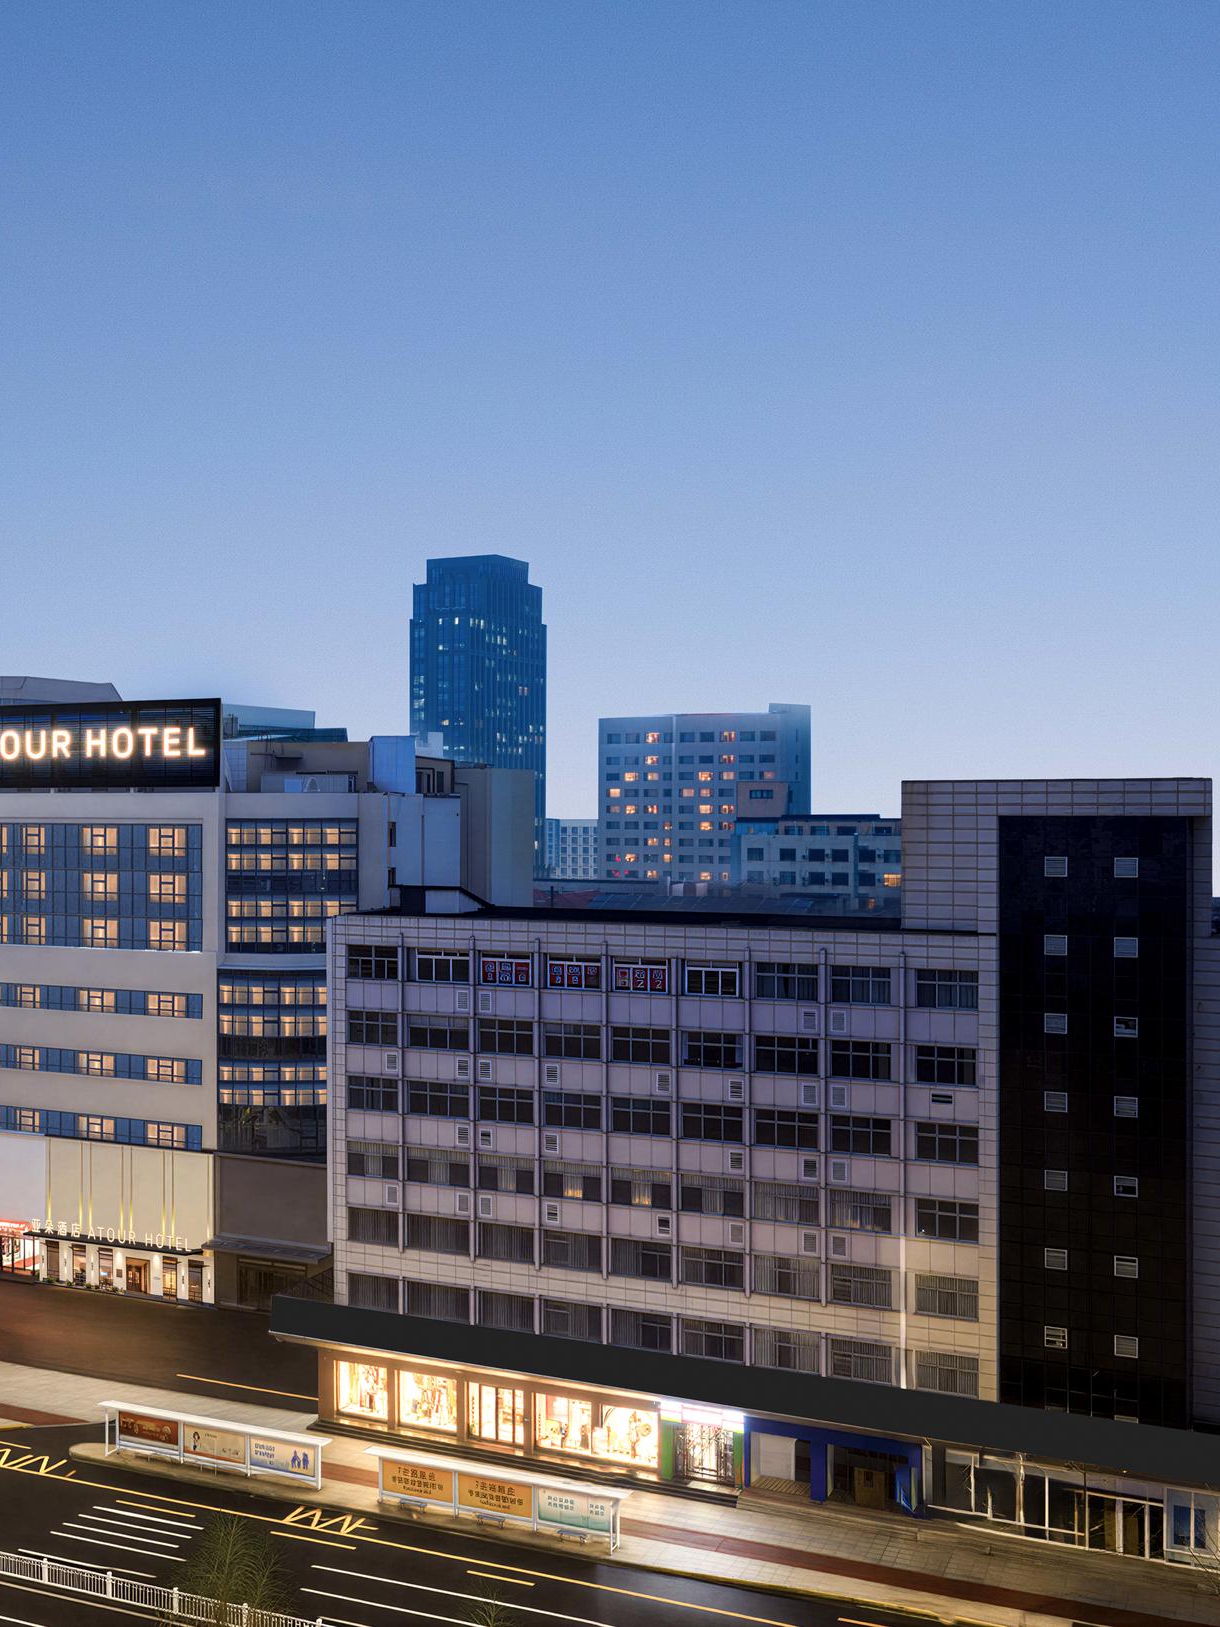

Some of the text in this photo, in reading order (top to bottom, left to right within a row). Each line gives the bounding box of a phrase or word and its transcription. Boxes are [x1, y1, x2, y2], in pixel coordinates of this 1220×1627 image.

[86, 726, 206, 758] HOTEL
[30, 1218, 81, 1239] 亚朵酒店
[88, 1226, 136, 1245] ATOUR
[145, 1232, 192, 1252] HOTEL
